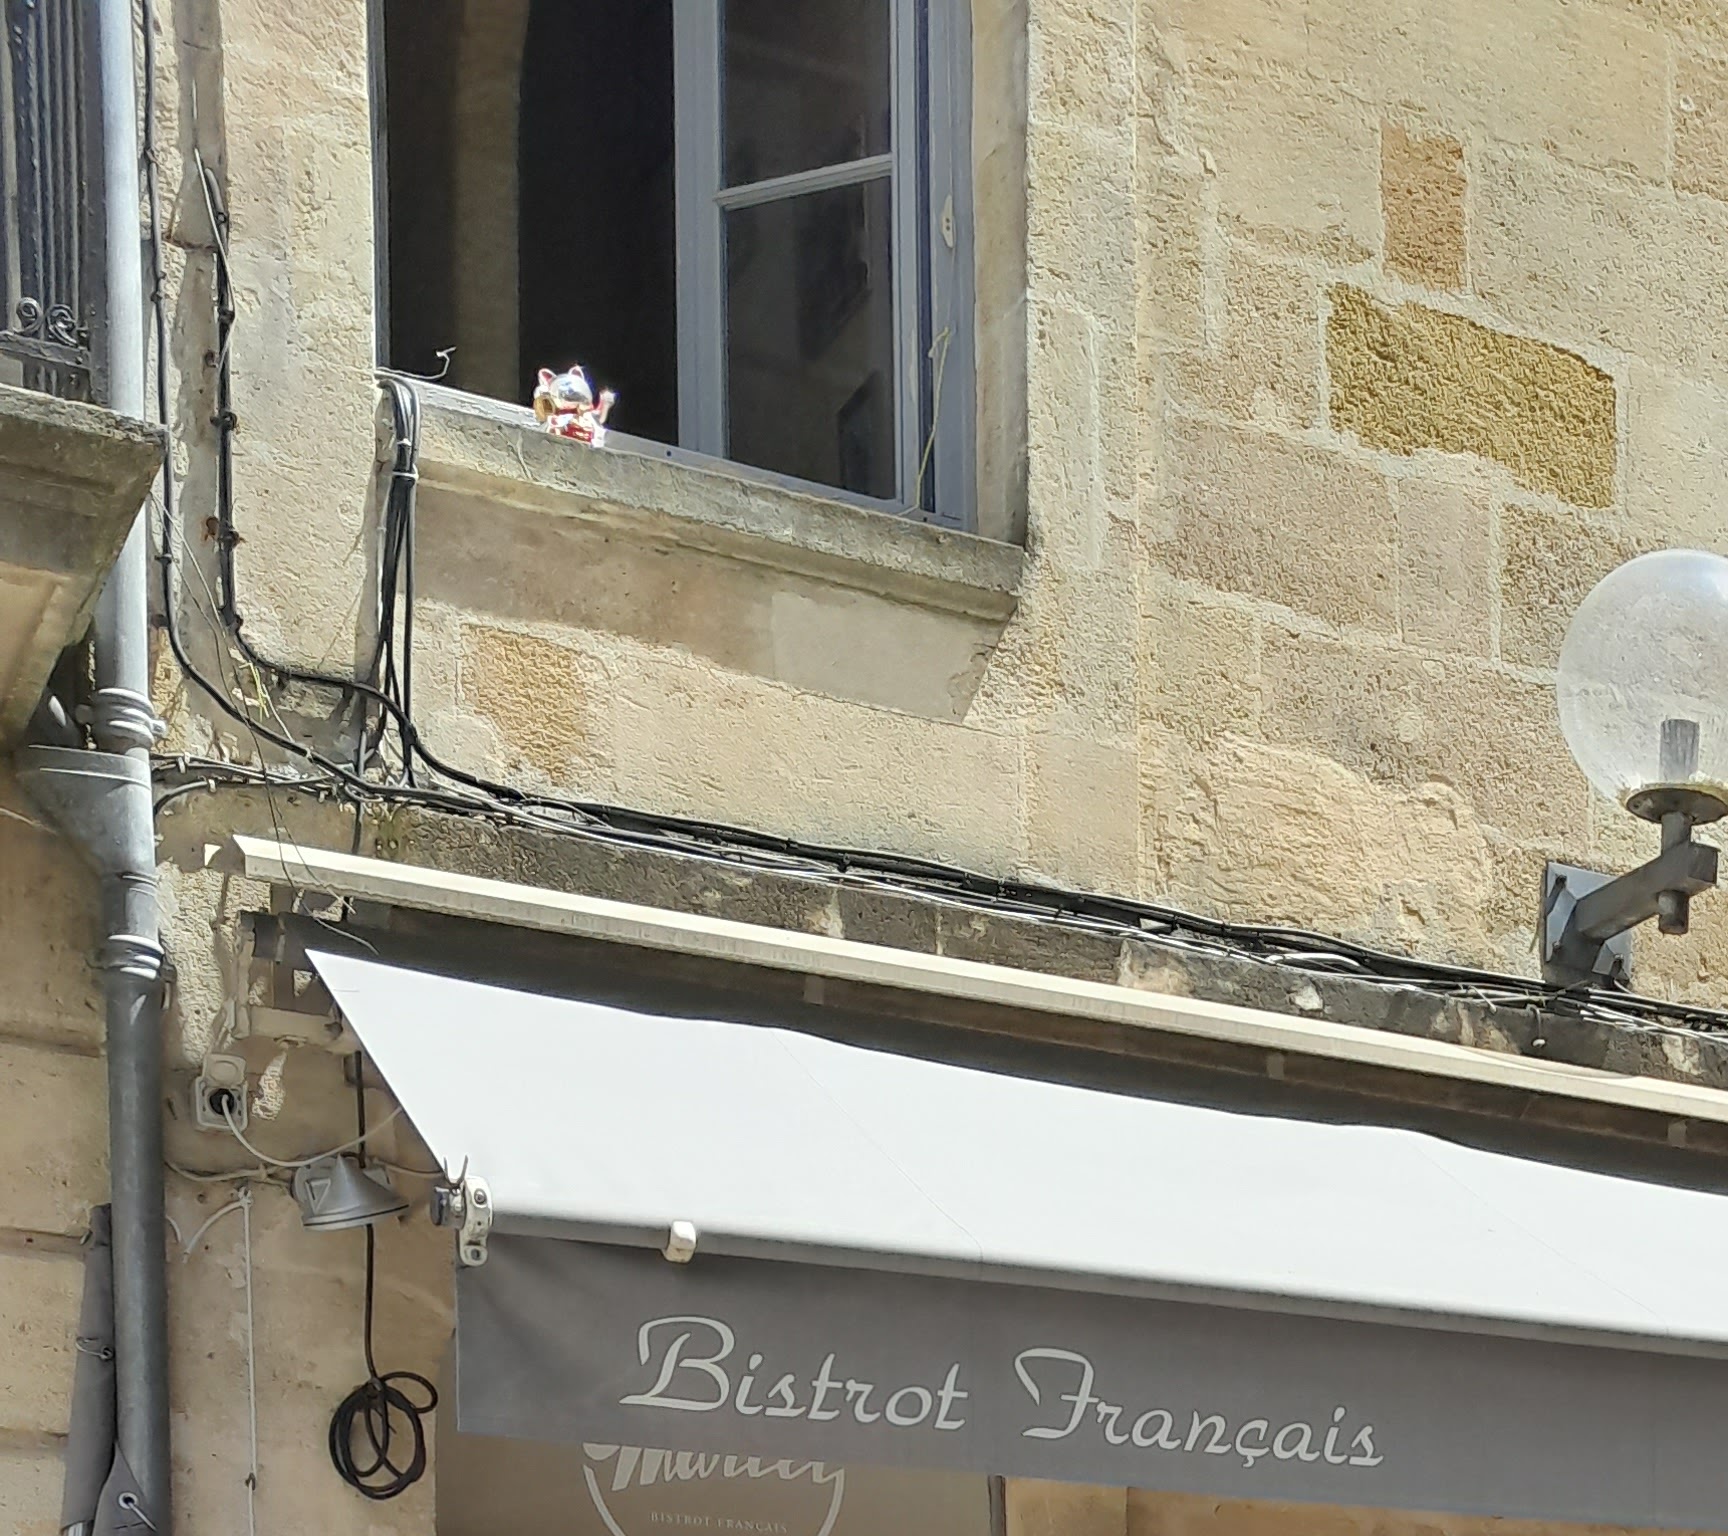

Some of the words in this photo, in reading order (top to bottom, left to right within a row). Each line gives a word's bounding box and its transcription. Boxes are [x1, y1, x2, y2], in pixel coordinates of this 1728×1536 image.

[620, 1315, 969, 1431] Bistrot
[1014, 1347, 1385, 1469] Français
[650, 1511, 710, 1527] BISTROT
